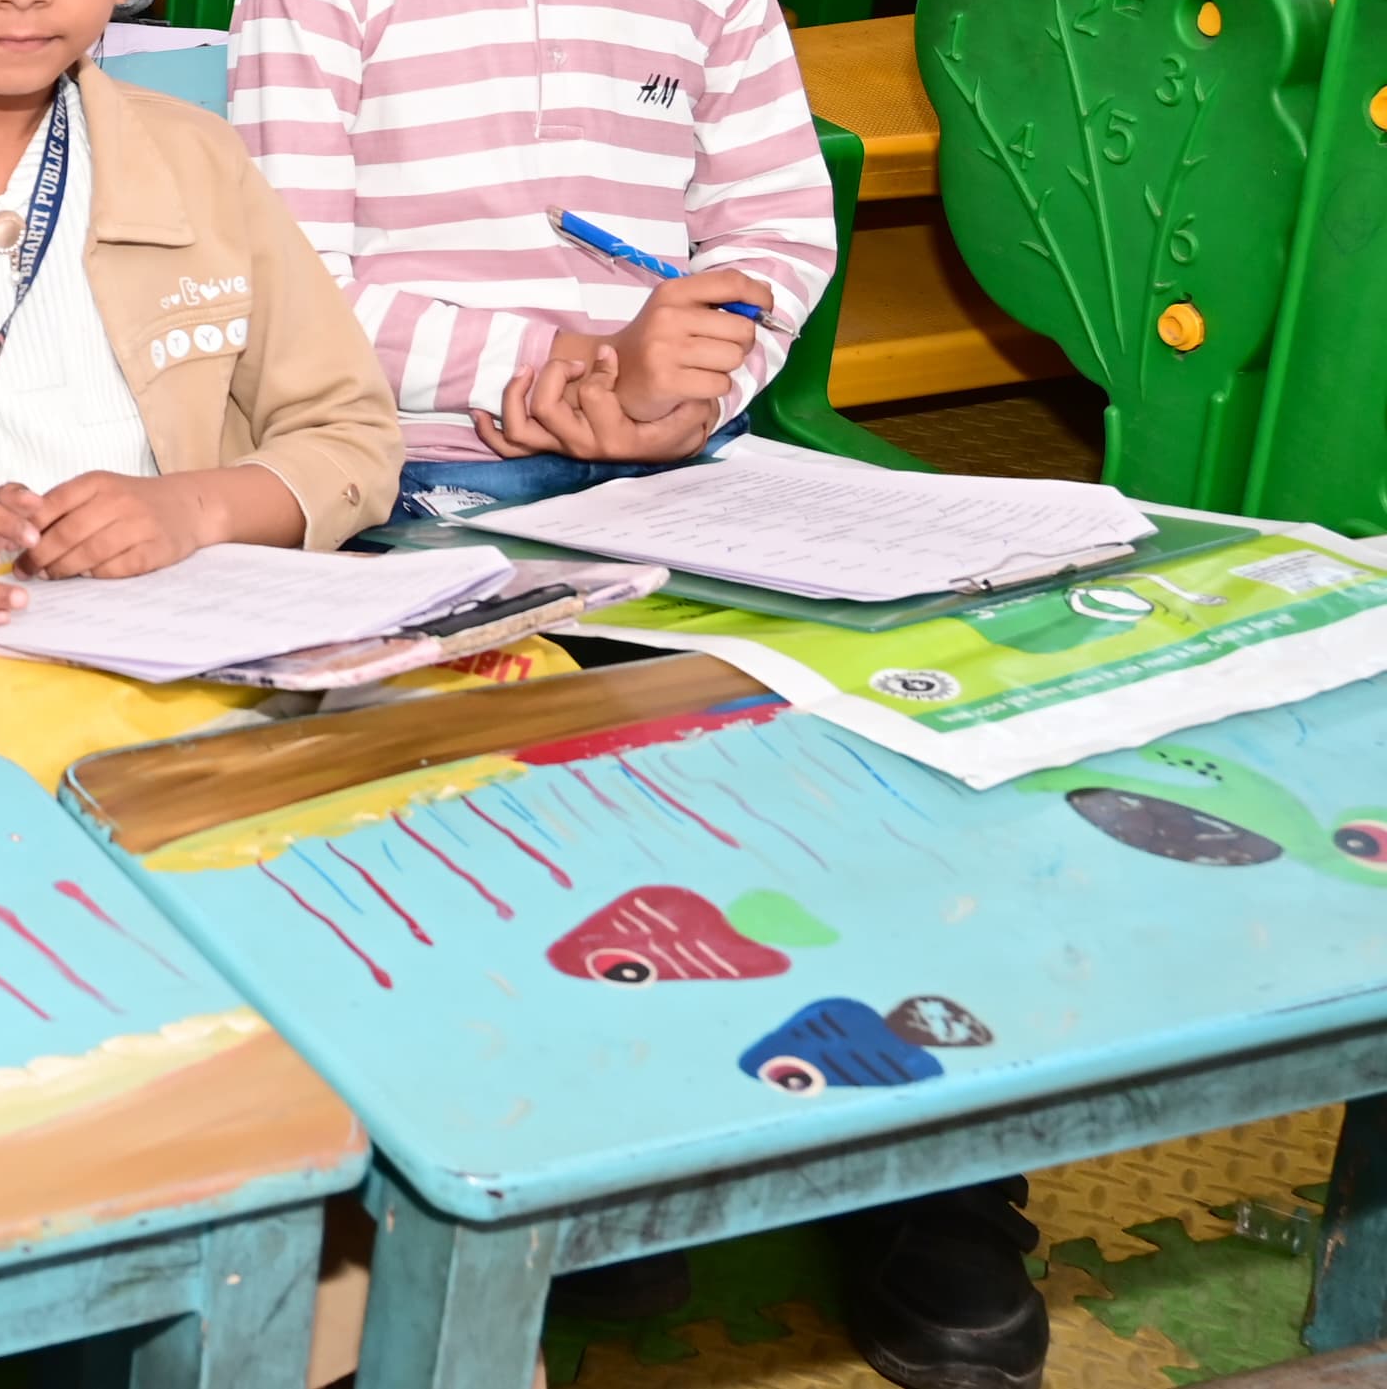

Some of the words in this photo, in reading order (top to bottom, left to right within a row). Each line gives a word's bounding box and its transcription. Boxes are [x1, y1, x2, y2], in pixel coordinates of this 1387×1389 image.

[946, 13, 964, 60] 1
[1155, 55, 1187, 106] 3
[1008, 122, 1035, 169] 4
[1103, 110, 1137, 164] 5
[35, 143, 64, 208] PUBLIC
[1171, 214, 1199, 264] 6
